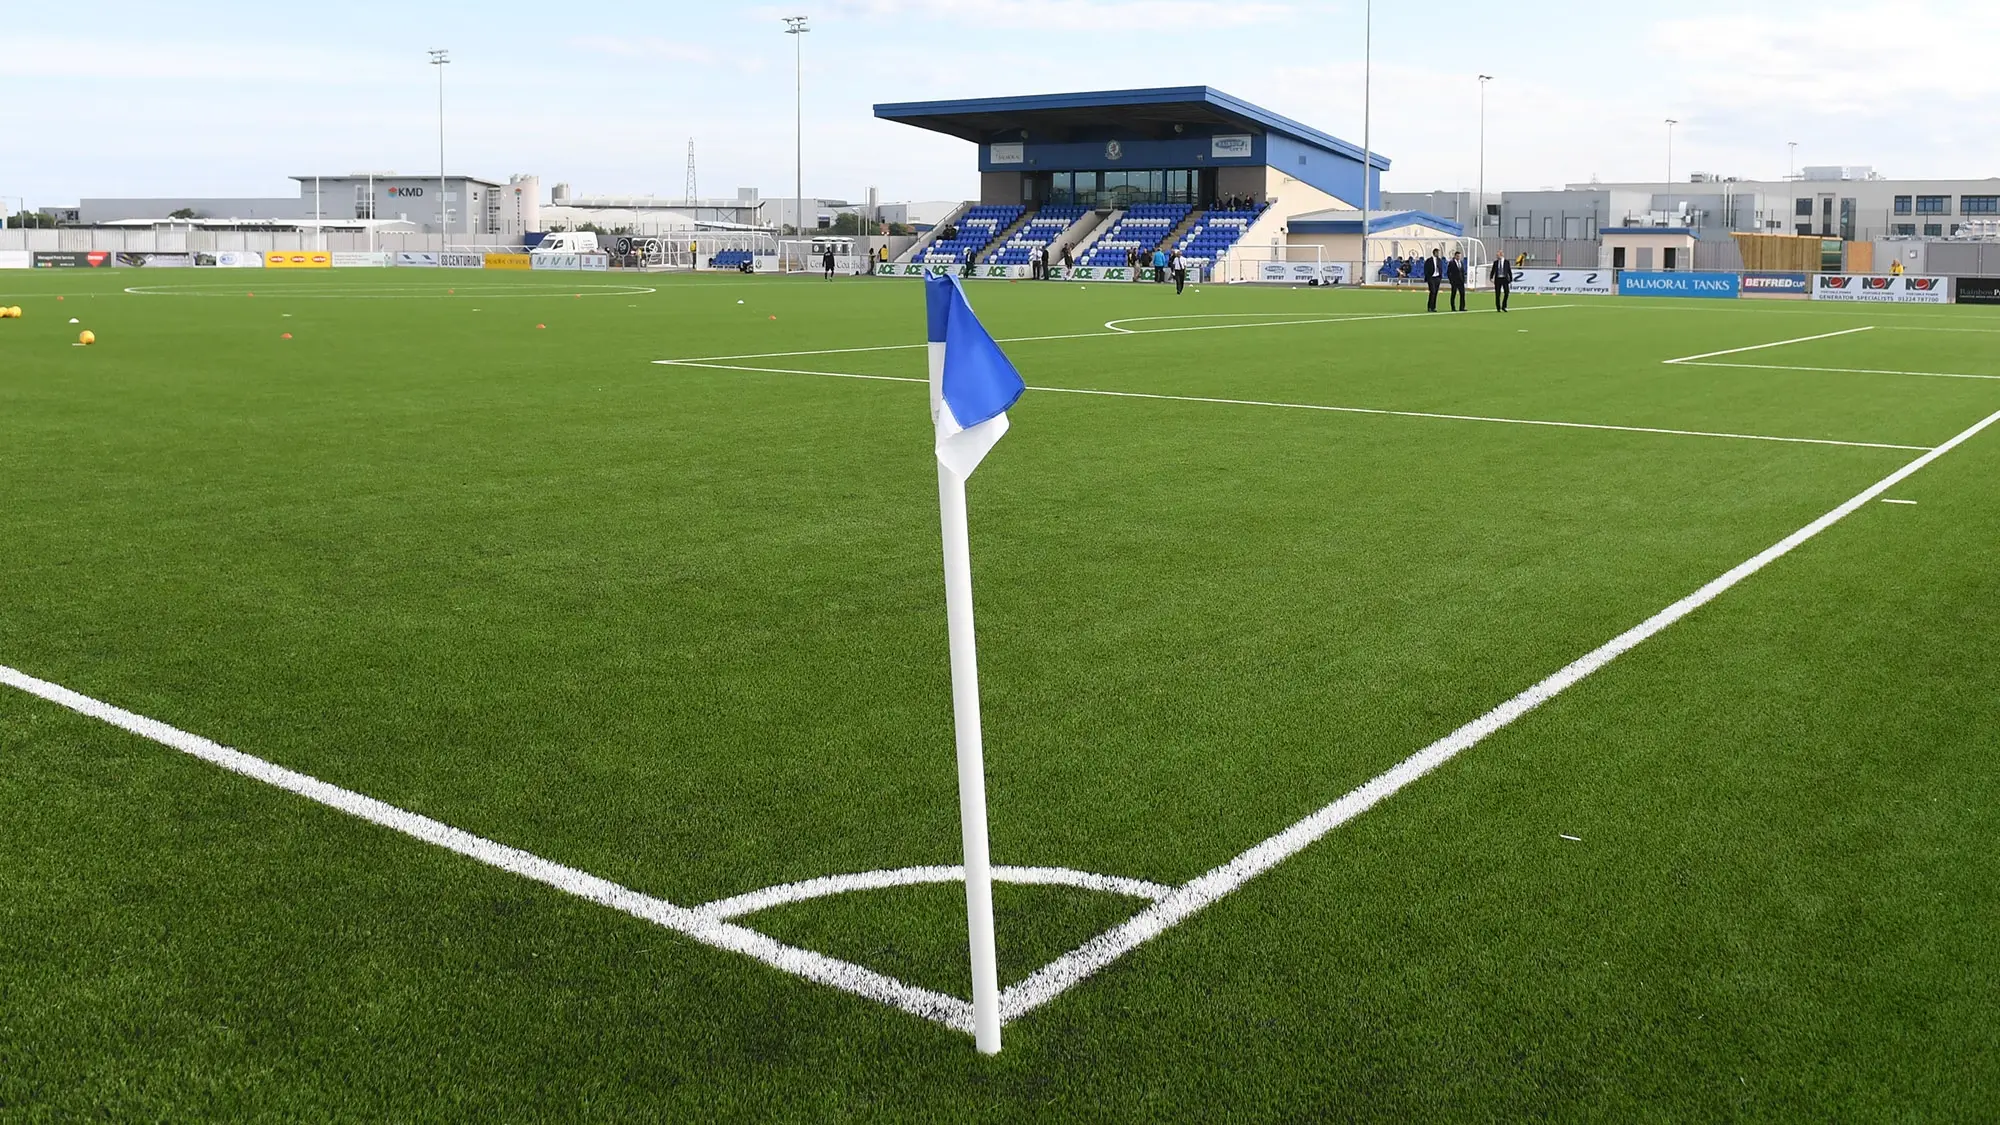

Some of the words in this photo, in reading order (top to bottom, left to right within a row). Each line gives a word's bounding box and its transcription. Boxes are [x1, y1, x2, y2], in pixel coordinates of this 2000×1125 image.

[398, 187, 424, 197] KMD
[449, 254, 481, 267] CENTURION
[877, 264, 895, 275] ACE
[904, 264, 922, 275] ACE
[932, 265, 949, 275] ACE
[958, 265, 977, 277] AE
[987, 266, 1007, 277] ACE
[1049, 267, 1063, 277] CE
[1072, 268, 1093, 279] ACE
[1103, 268, 1125, 279] ACE
[1626, 278, 1688, 290] BALMORAL
[1693, 279, 1730, 291] TANKS
[1745, 278, 1793, 288] BETFRED
[1820, 276, 1852, 289] NOV
[1862, 277, 1895, 290] NOV
[1905, 278, 1939, 291] NOV
[1960, 288, 1993, 296] Rainbow
